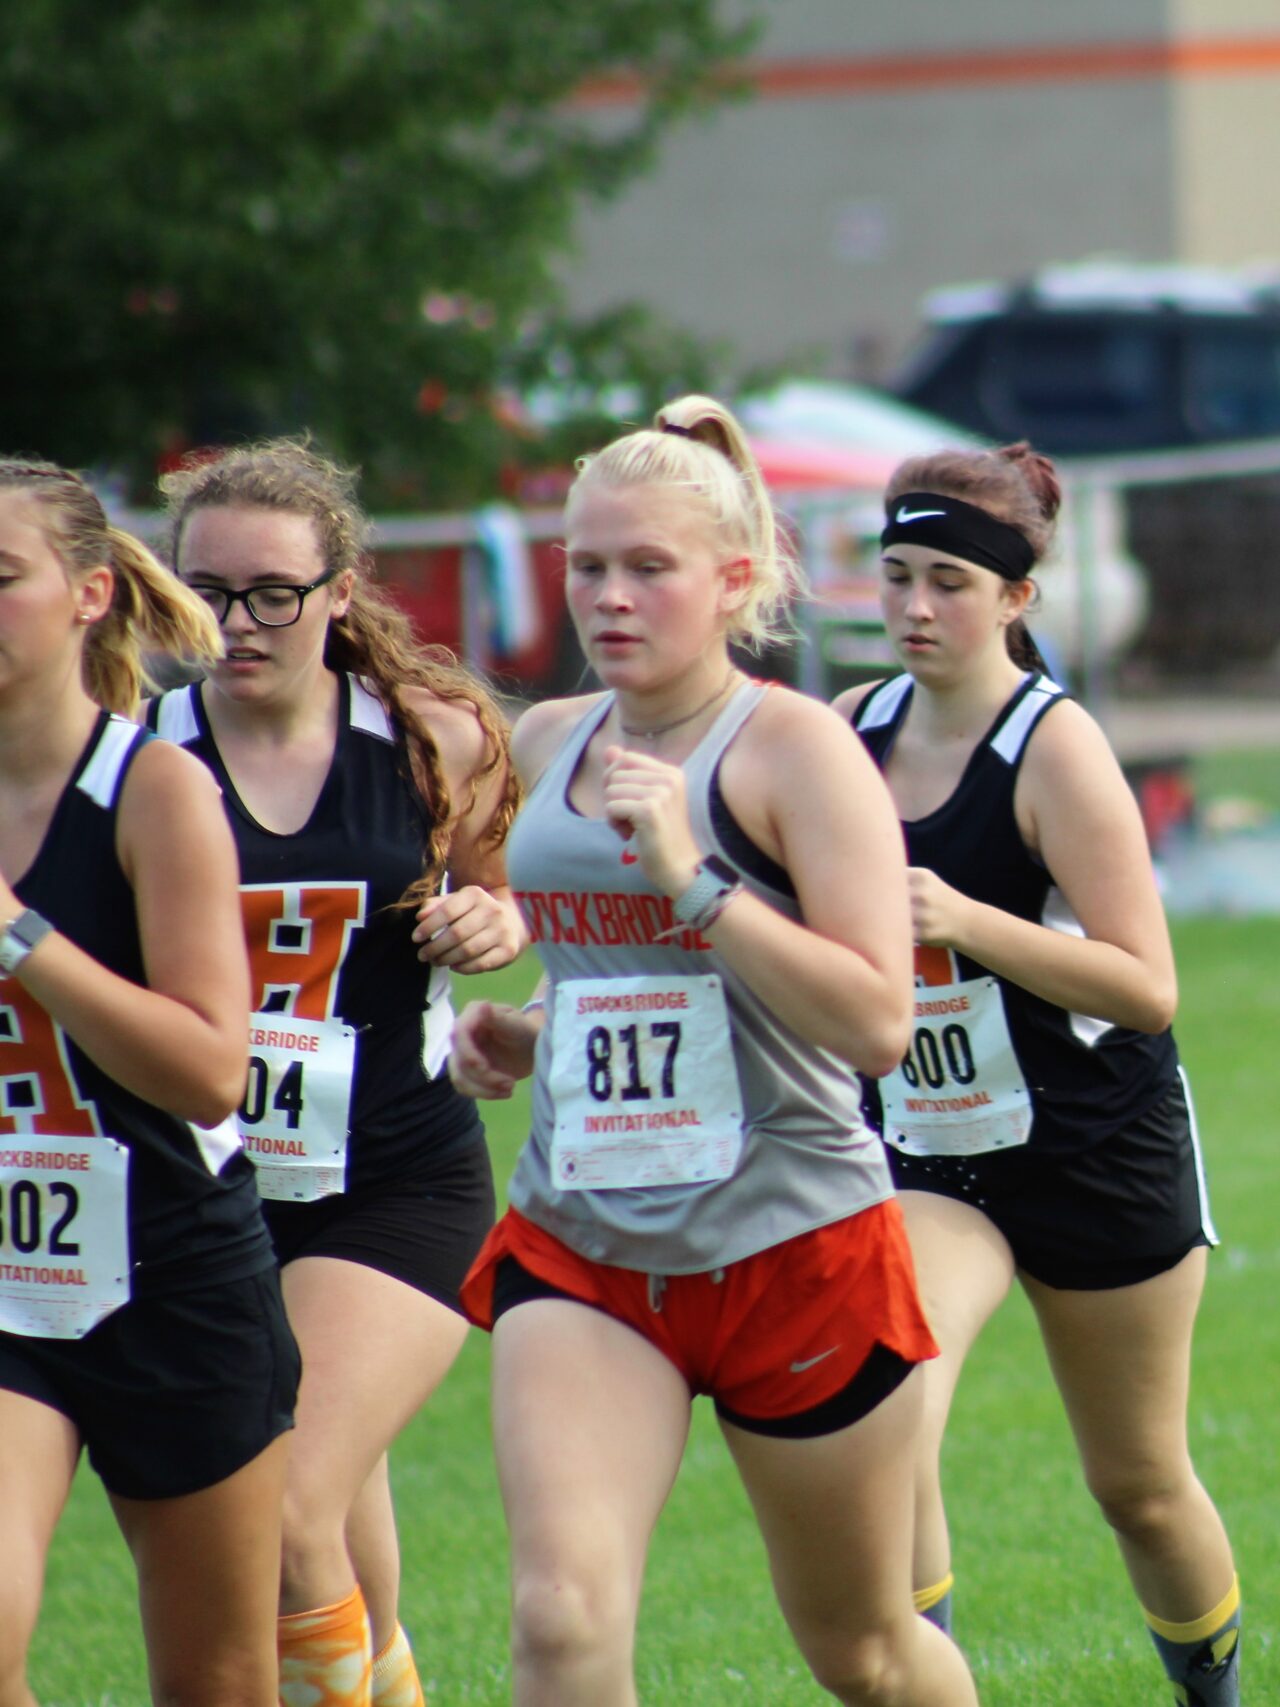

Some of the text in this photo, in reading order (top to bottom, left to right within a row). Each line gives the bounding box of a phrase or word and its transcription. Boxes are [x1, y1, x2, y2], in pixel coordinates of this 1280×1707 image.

[576, 991, 689, 1015] STOCKBRIDGE
[238, 1056, 304, 1130] 04
[587, 1021, 681, 1102] 817
[584, 1109, 702, 1134] INVITATIONAL
[0, 1180, 80, 1256] 02
